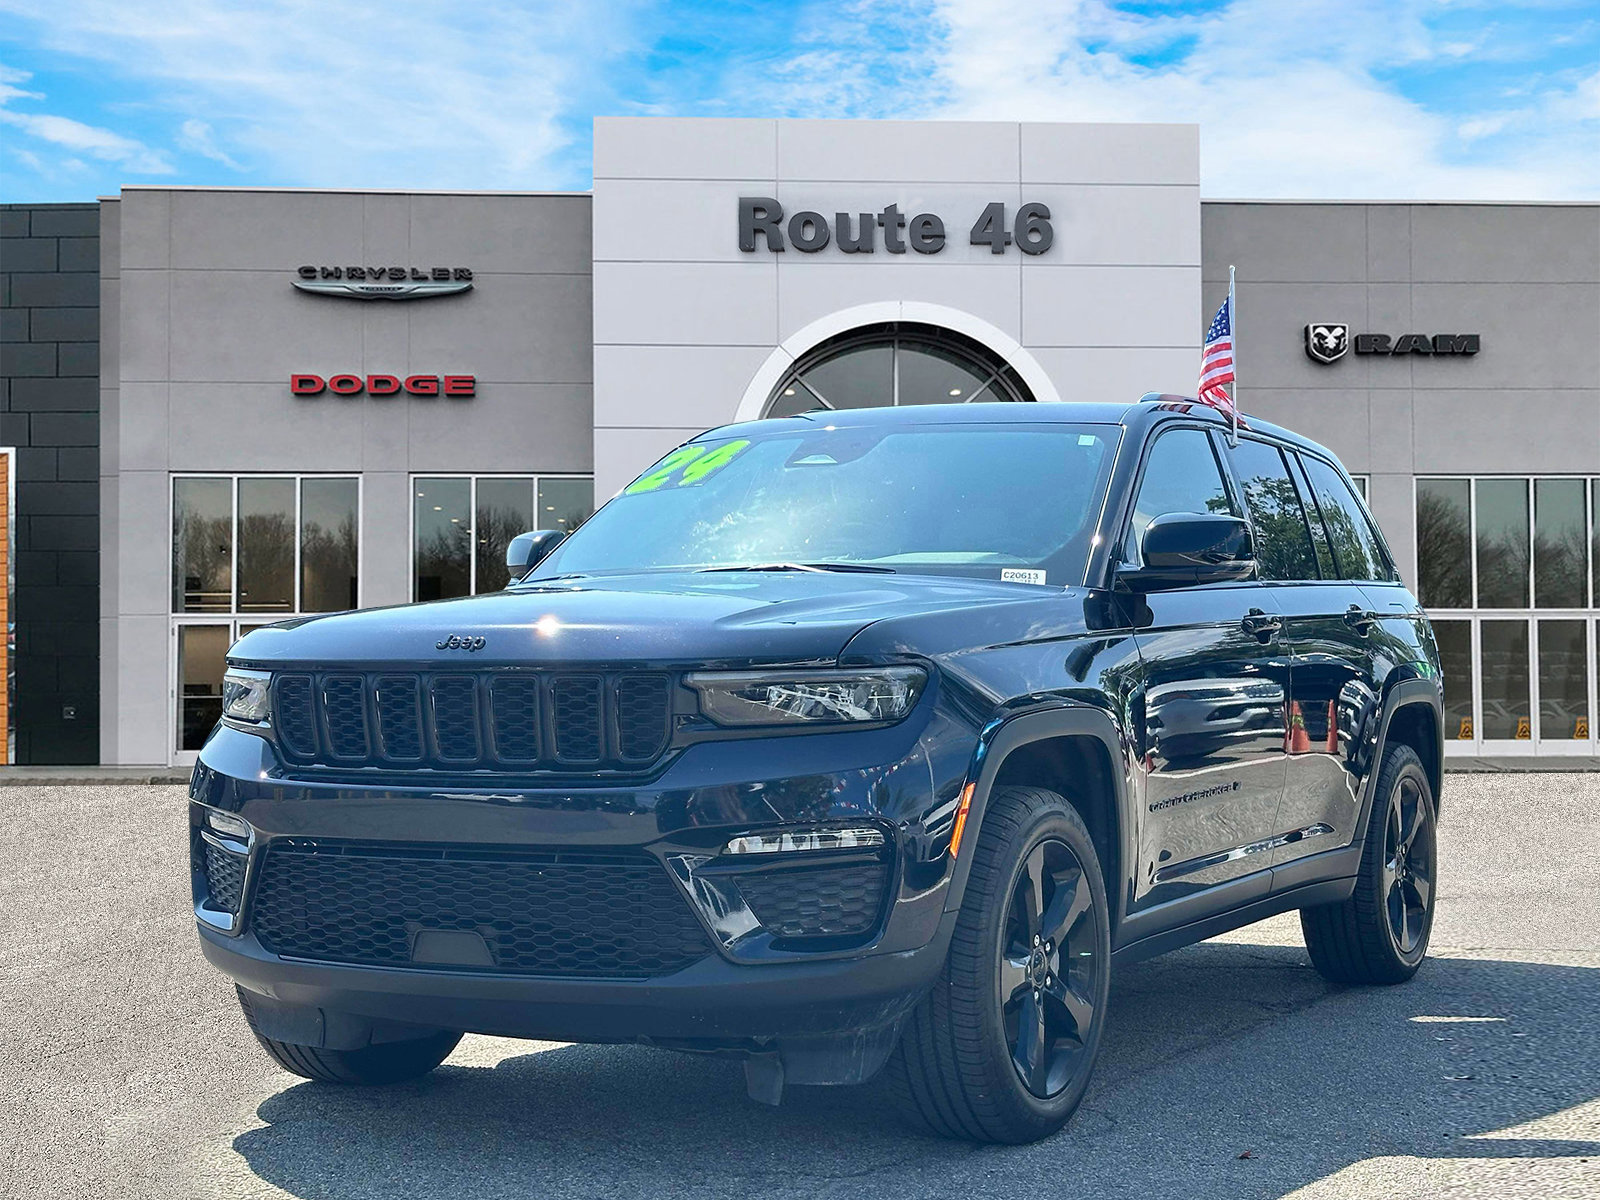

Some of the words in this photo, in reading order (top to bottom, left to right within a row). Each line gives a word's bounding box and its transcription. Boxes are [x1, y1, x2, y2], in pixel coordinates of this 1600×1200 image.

[739, 196, 946, 254] Route
[970, 202, 1054, 255] 46
[298, 266, 473, 280] CHRYSLER
[1354, 334, 1480, 355] RAM
[291, 374, 476, 396] DODGE
[624, 439, 751, 496] 24
[1003, 571, 1039, 580] C20613
[435, 633, 487, 653] Jeep
